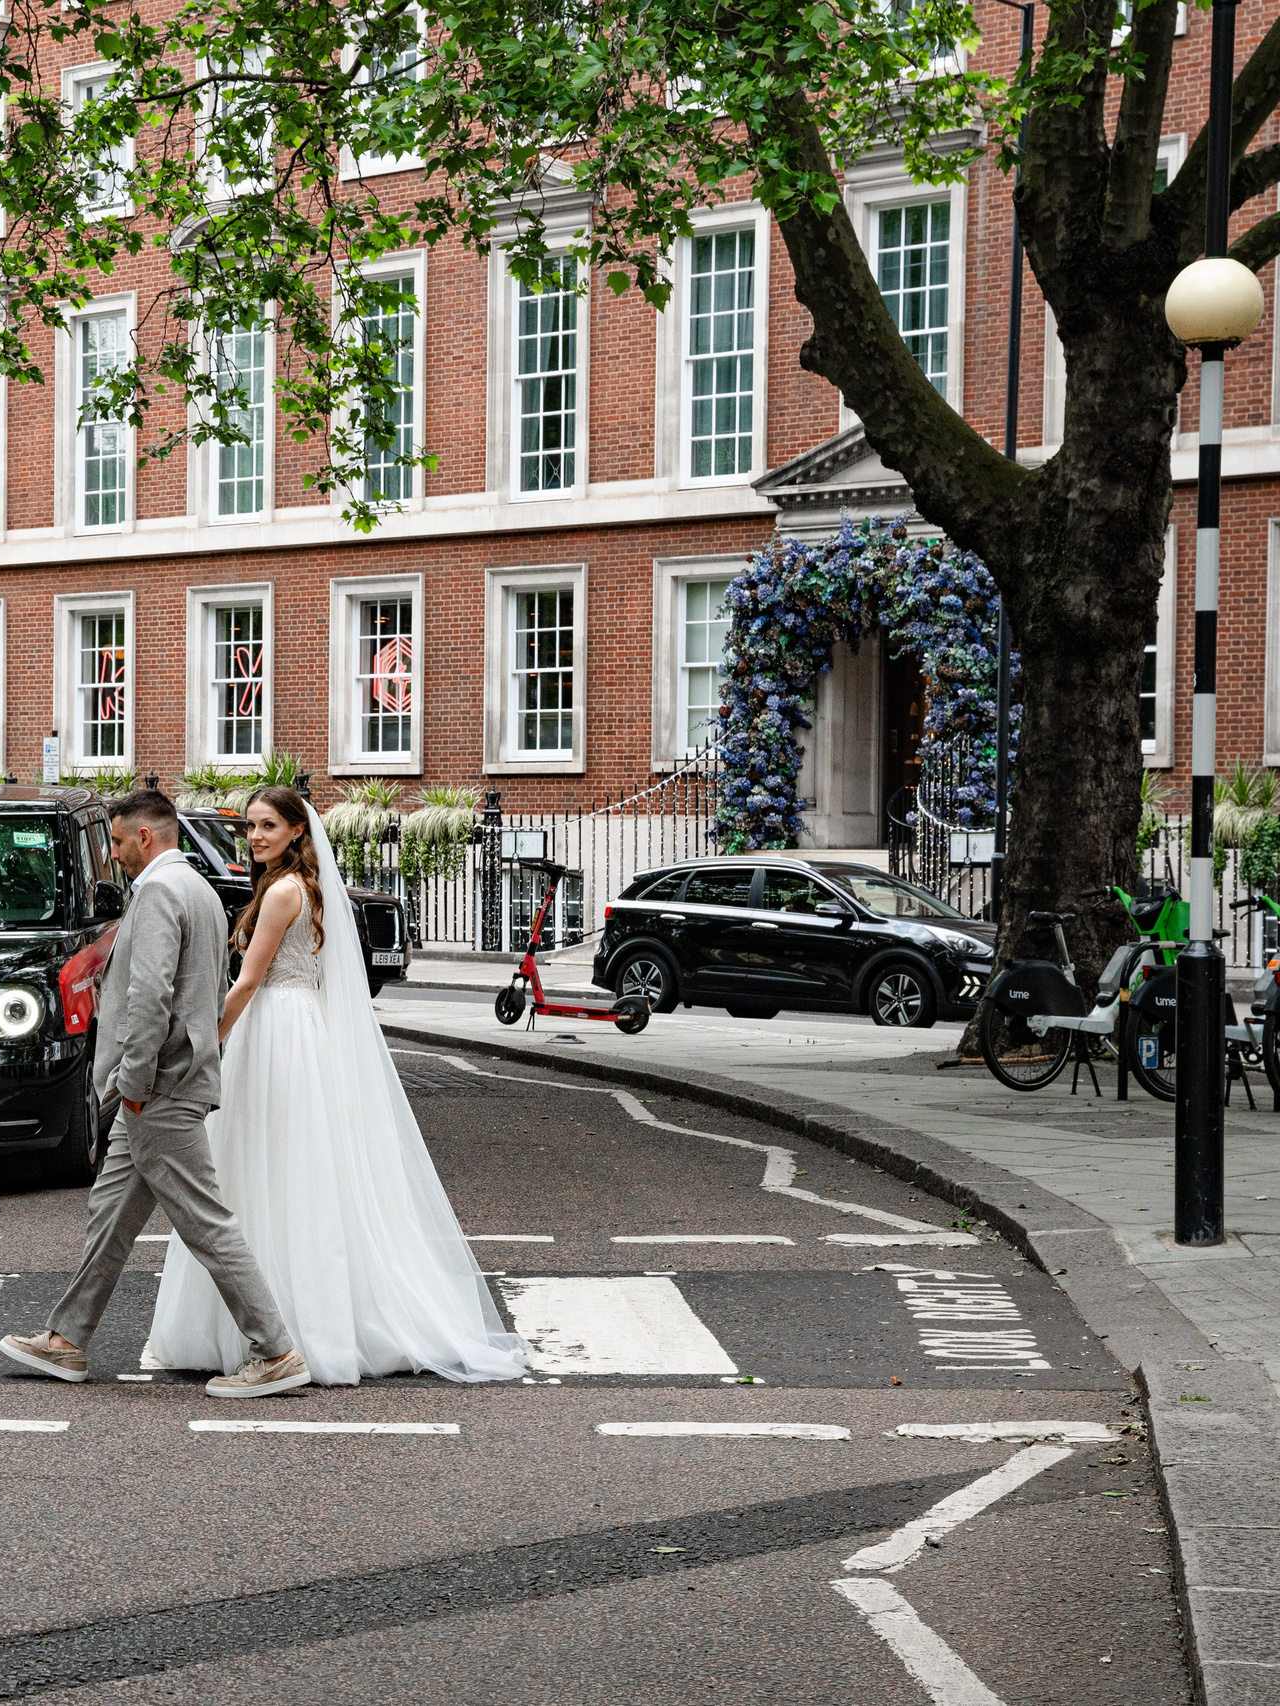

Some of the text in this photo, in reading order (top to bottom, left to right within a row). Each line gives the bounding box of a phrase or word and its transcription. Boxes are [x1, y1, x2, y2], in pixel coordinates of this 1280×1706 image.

[375, 954, 401, 964] LE19 XEA
[1009, 989, 1030, 1000] Lime
[897, 1278, 1052, 1370] LOOK RIGHT
